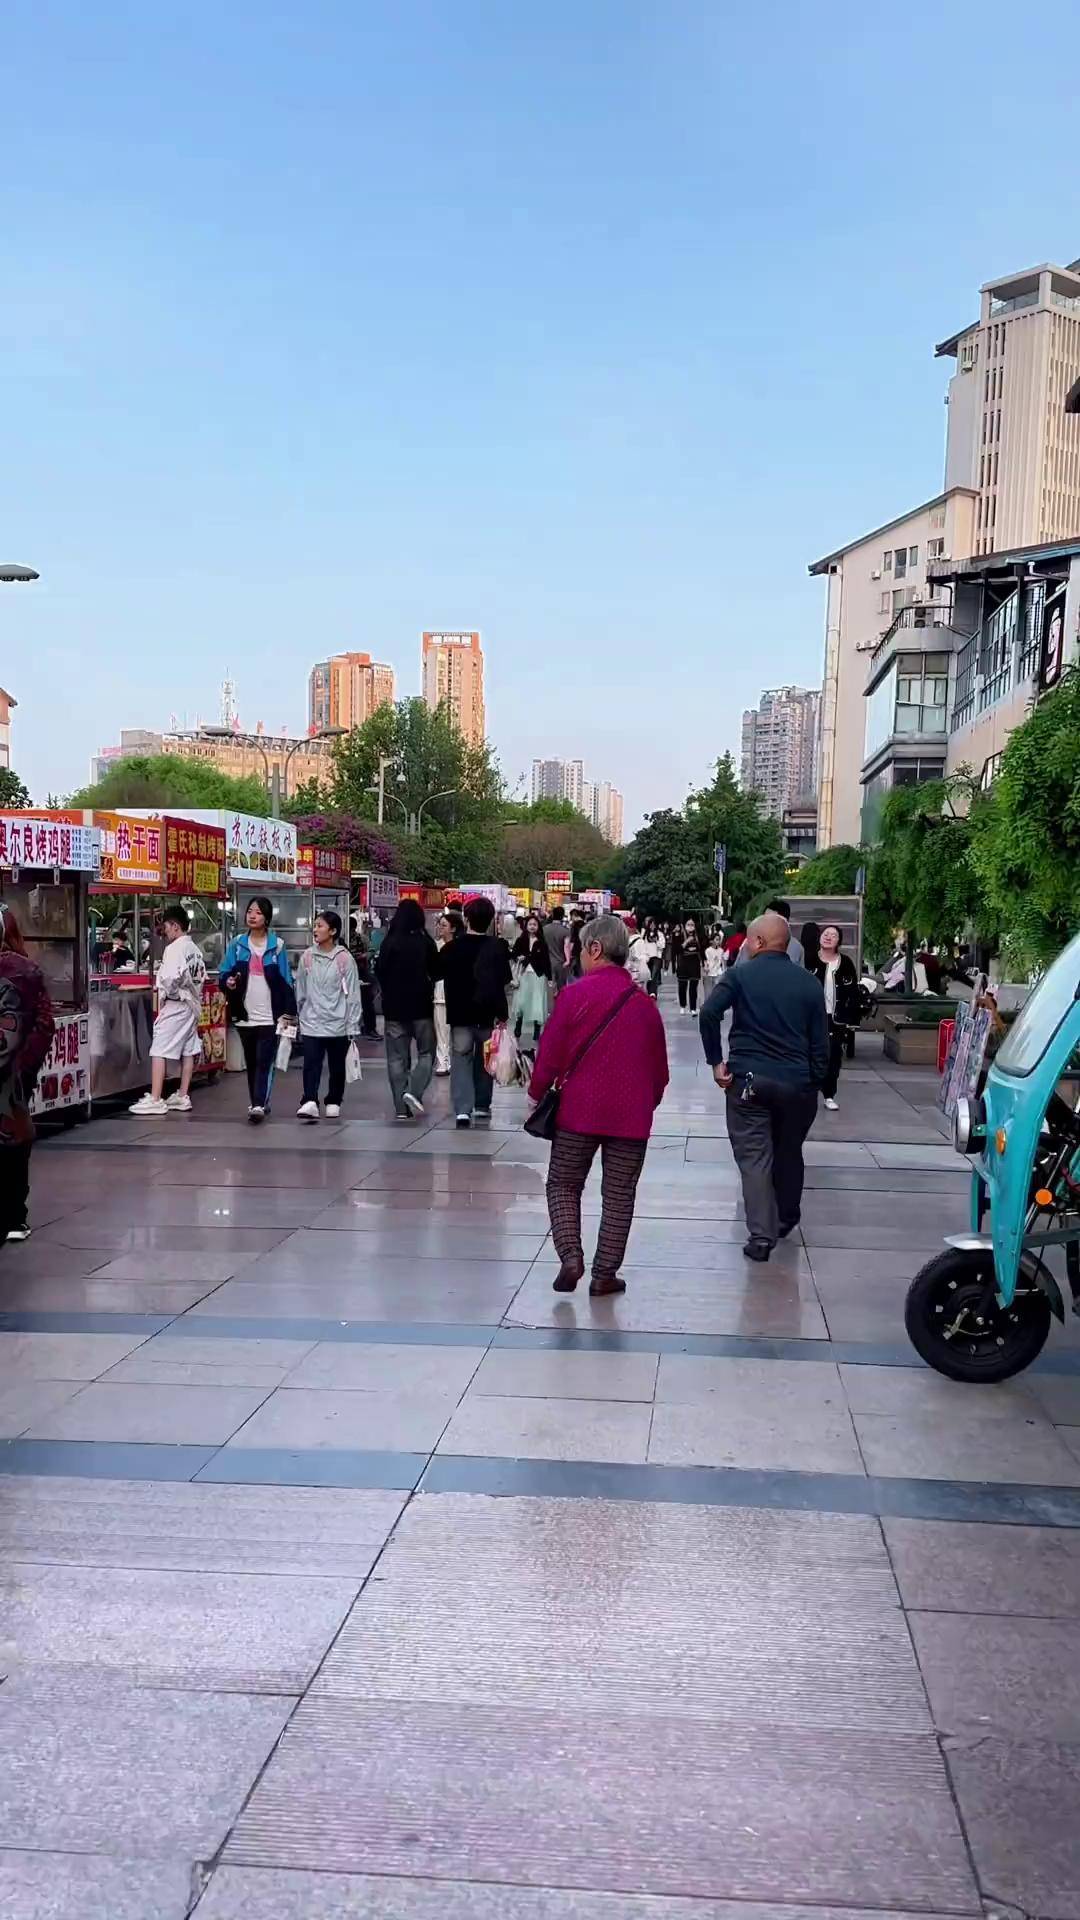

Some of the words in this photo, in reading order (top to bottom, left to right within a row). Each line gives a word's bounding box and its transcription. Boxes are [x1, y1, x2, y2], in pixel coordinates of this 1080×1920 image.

[0, 819, 71, 865] 奥尔良烤鸡腿
[117, 820, 160, 864] 热干面
